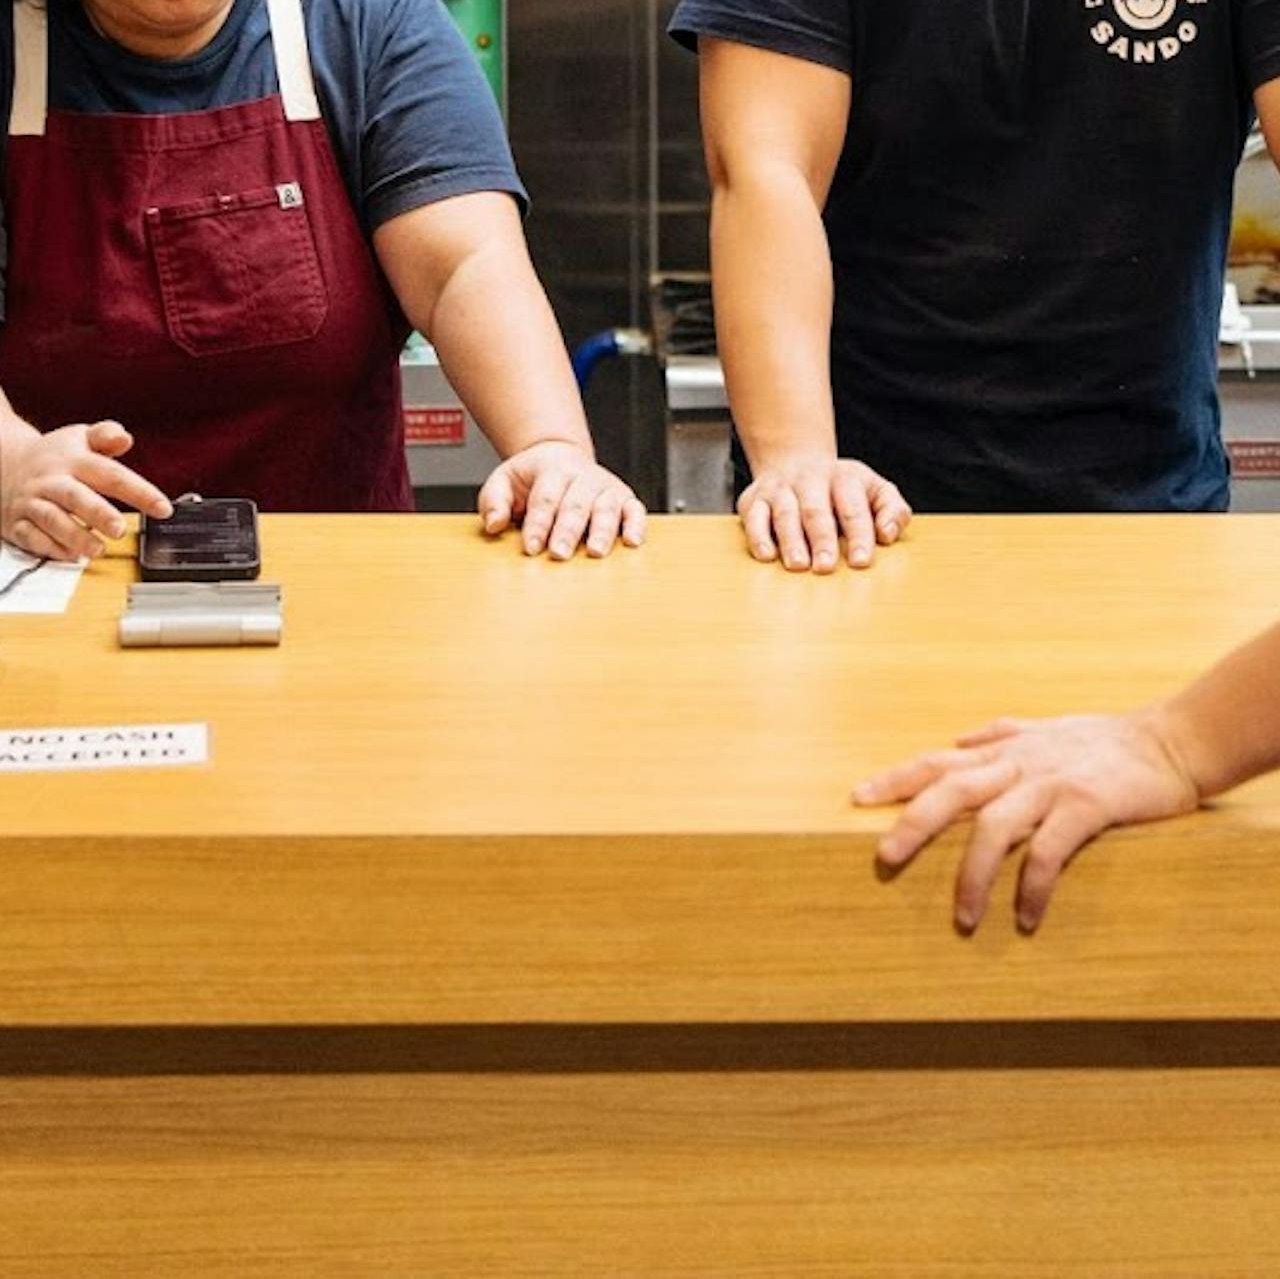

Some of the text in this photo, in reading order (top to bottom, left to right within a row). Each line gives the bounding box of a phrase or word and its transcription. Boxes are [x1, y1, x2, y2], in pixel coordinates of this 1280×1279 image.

[1090, 20, 1198, 64] SANDO
[9, 730, 176, 746] NO CASH
